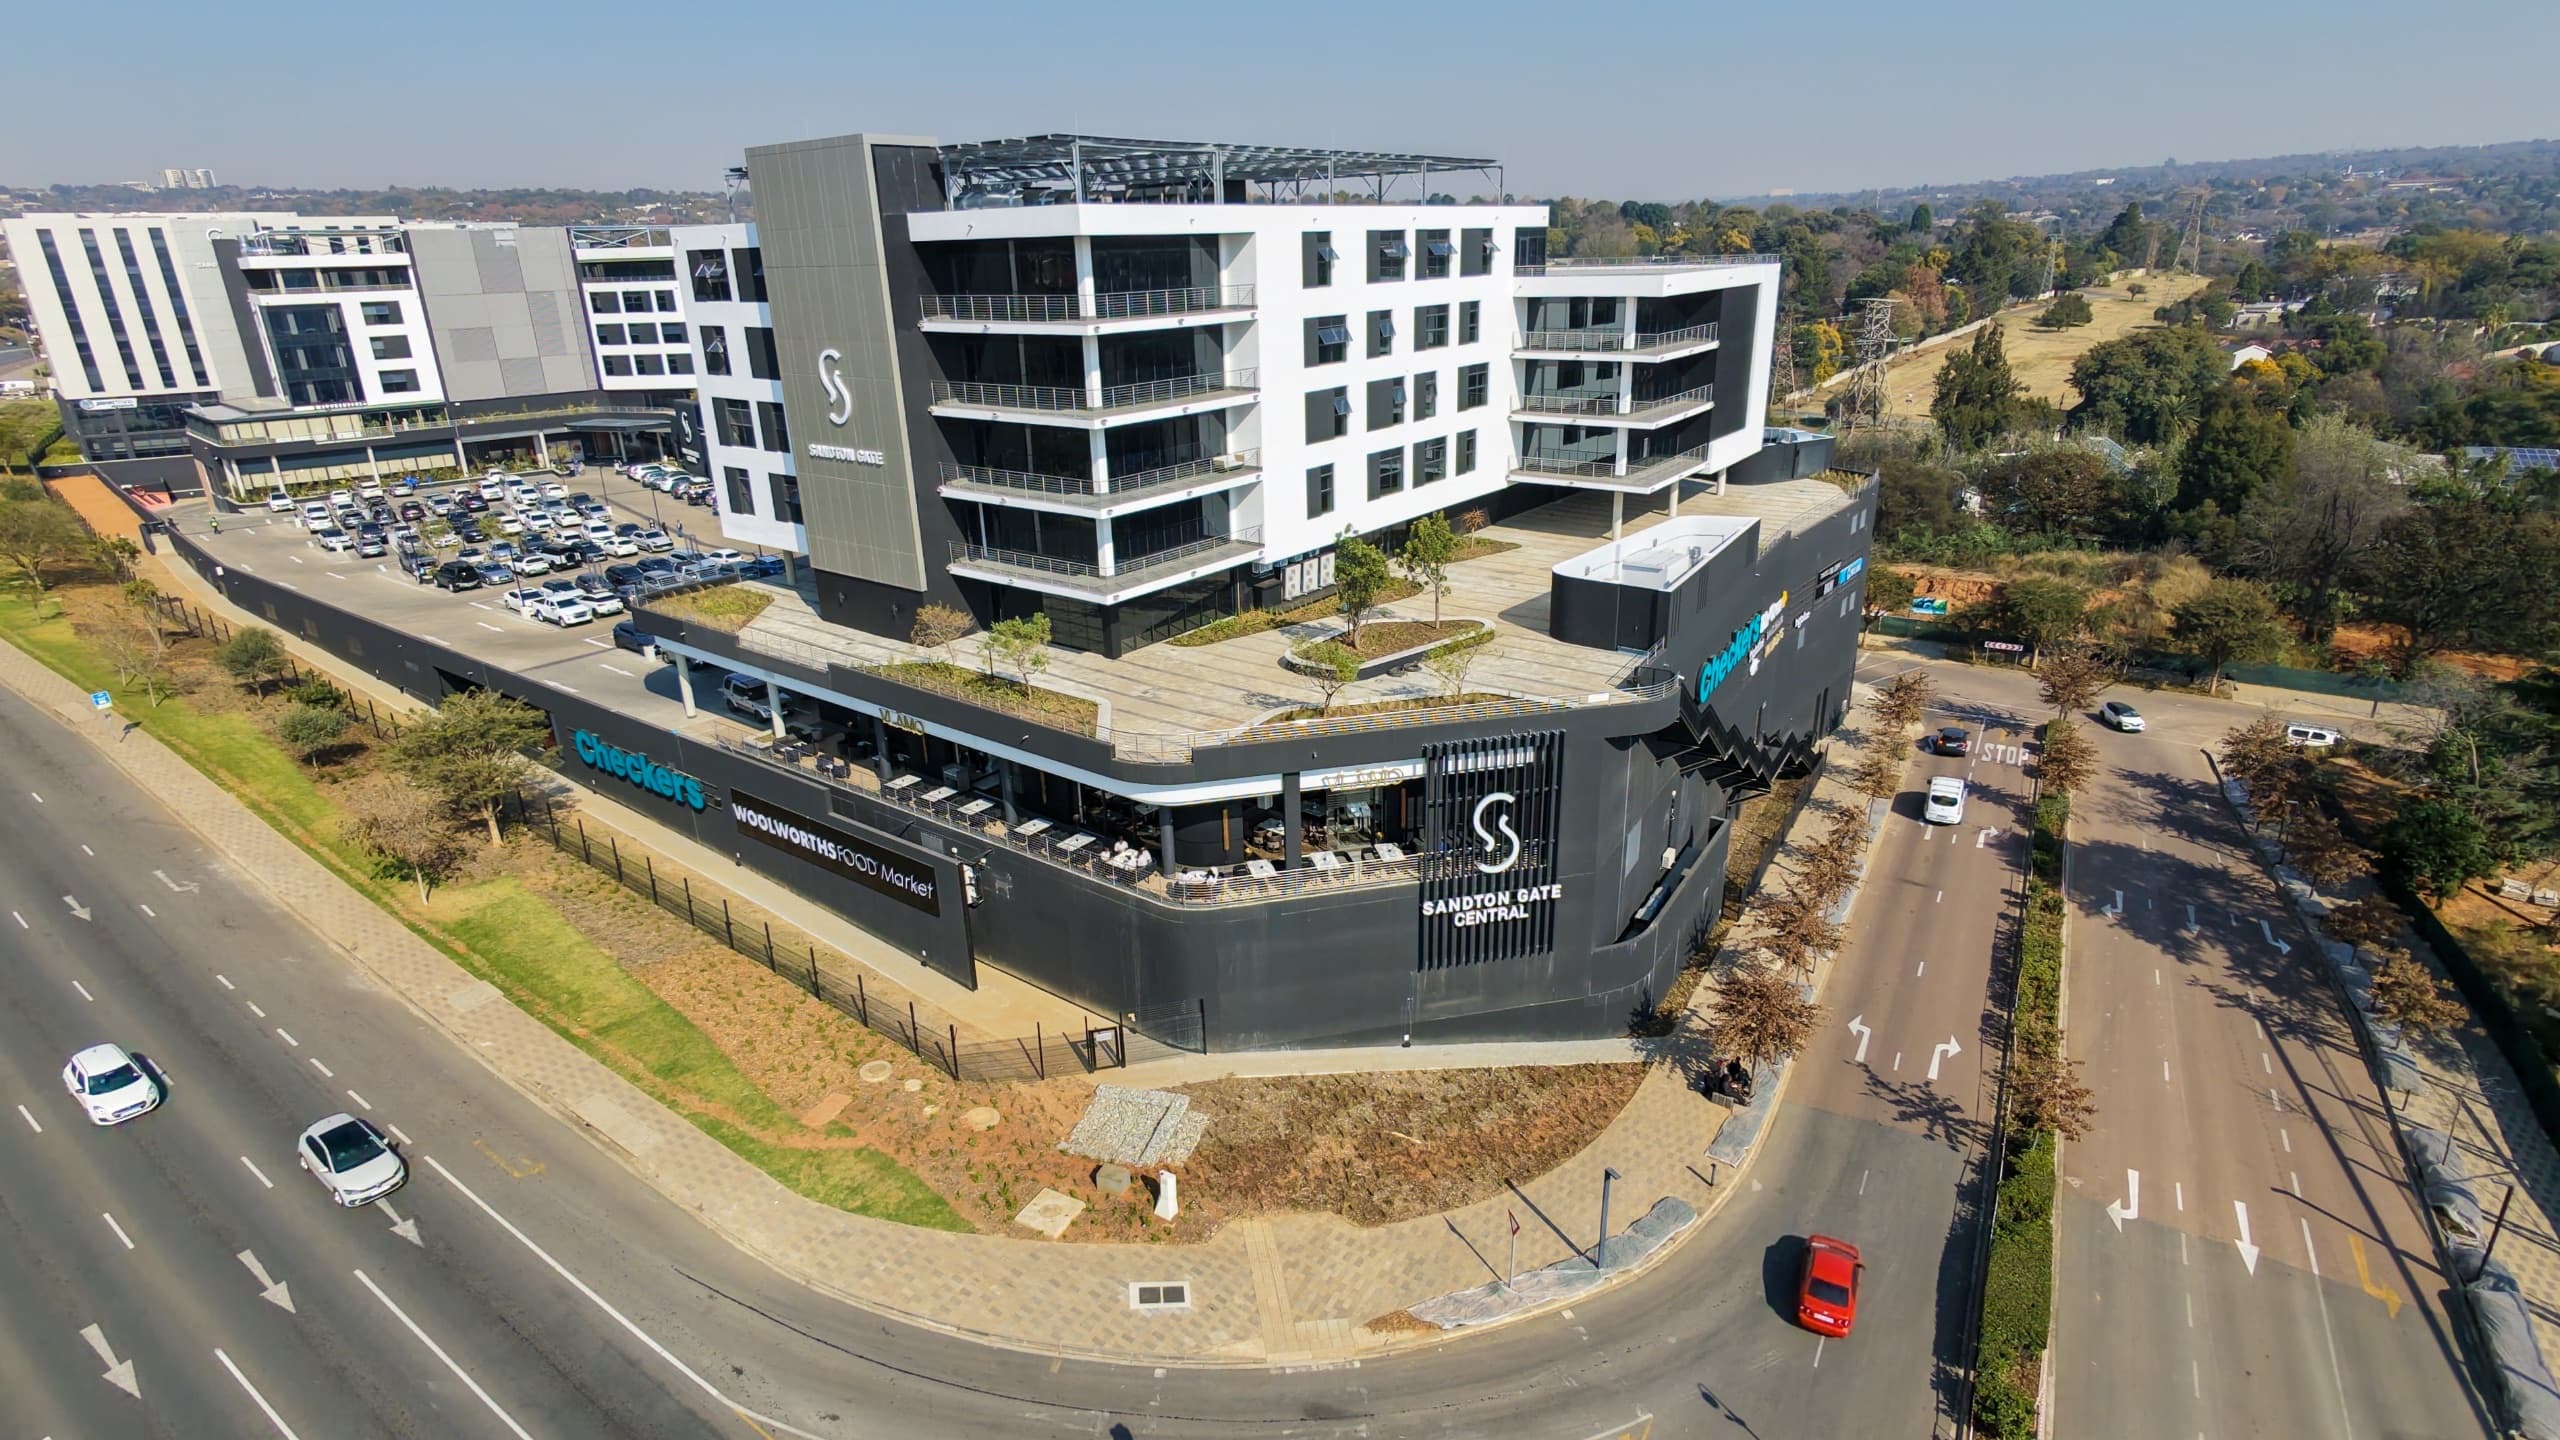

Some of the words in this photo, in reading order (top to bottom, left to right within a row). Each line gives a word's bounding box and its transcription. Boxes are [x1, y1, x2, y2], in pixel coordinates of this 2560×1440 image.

[808, 444, 856, 461] SANDTON
[857, 449, 885, 465] GATE
[1699, 612, 1762, 704] Checkers
[575, 729, 705, 810] Checkers
[1981, 742, 2030, 767] STOP
[881, 864, 934, 900] Market
[1422, 891, 1511, 916] SANDTON
[1517, 884, 1562, 903] GATE
[1454, 904, 1529, 927] CENTRAL
